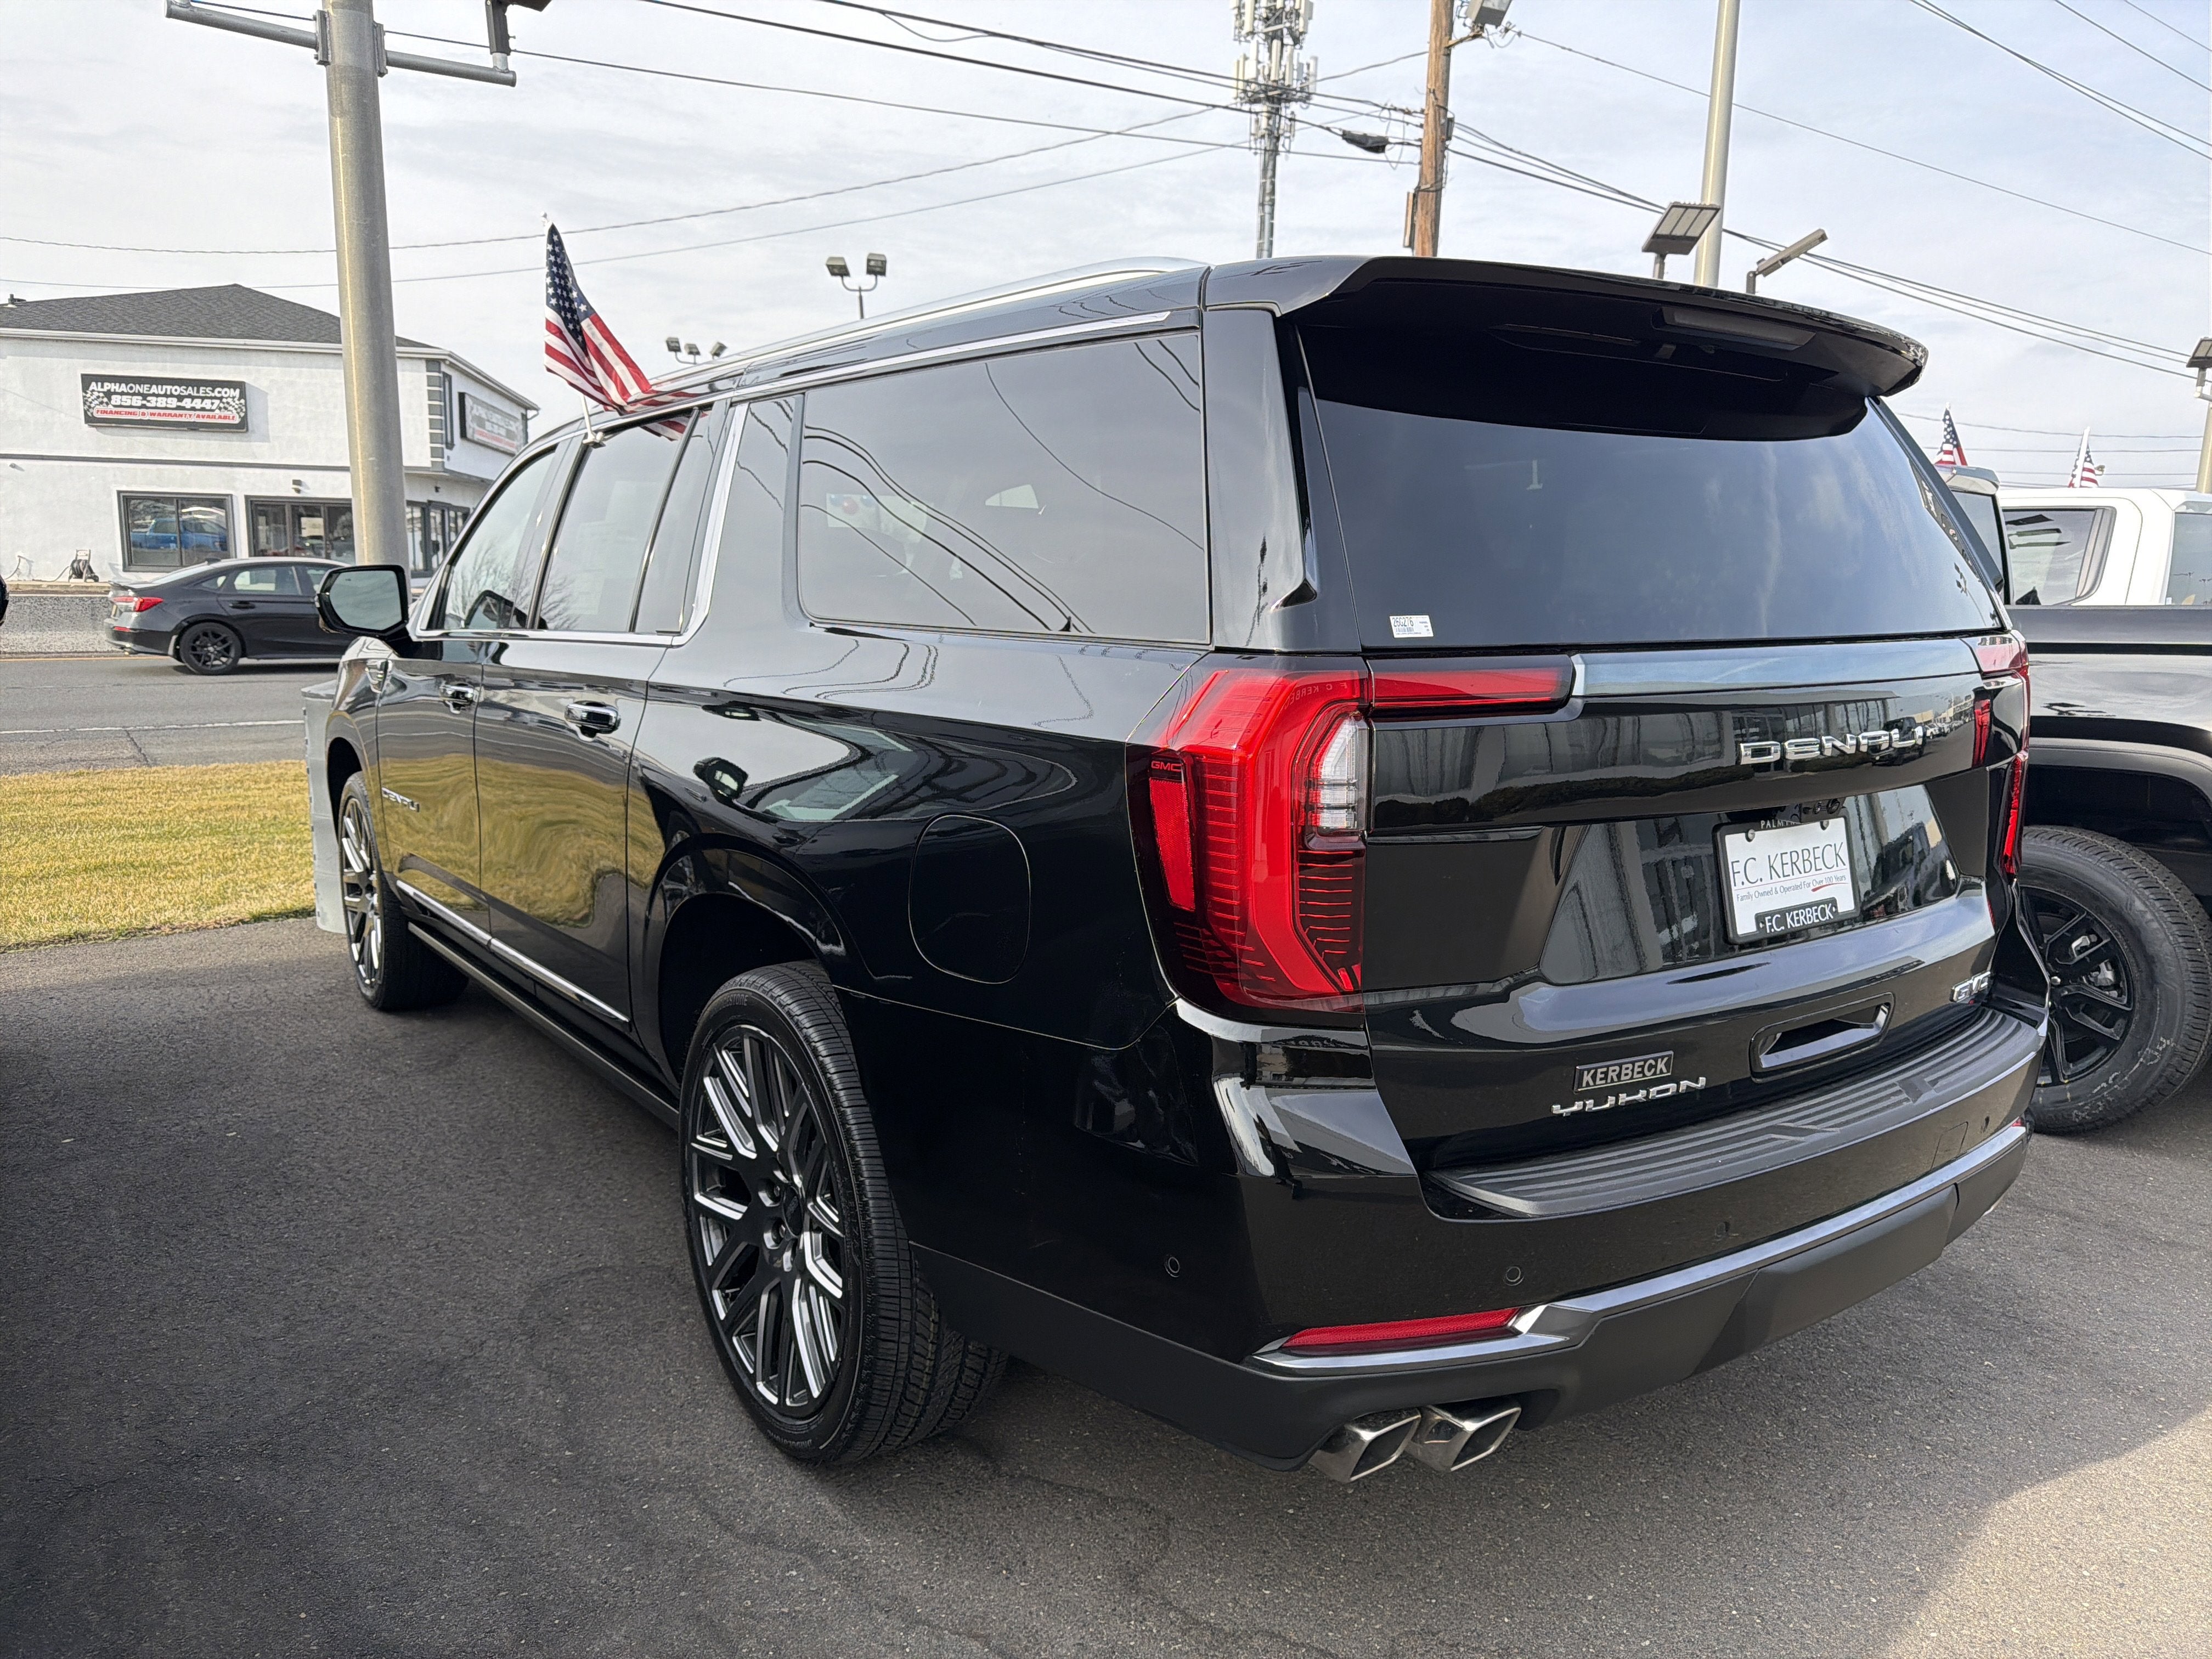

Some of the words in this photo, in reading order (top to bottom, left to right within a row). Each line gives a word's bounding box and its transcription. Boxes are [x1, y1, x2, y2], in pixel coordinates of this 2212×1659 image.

[89, 382, 240, 398] ALPHAONEAUTOSALES.COM
[110, 395, 220, 409] 856-389-4447
[1151, 760, 1182, 772] GMC
[1760, 819, 1796, 829] PALM
[1731, 857, 1763, 887] F.C.
[1768, 842, 1846, 880] KERBECK
[1736, 891, 1753, 902] Family
[1754, 889, 1773, 899] Owned
[1779, 884, 1803, 896] Operated
[1765, 914, 1785, 933] F.C.
[1786, 904, 1833, 929] KERBECK
[1582, 1057, 1669, 1087] KERBECK
[1551, 1077, 1706, 1116] YUKON
